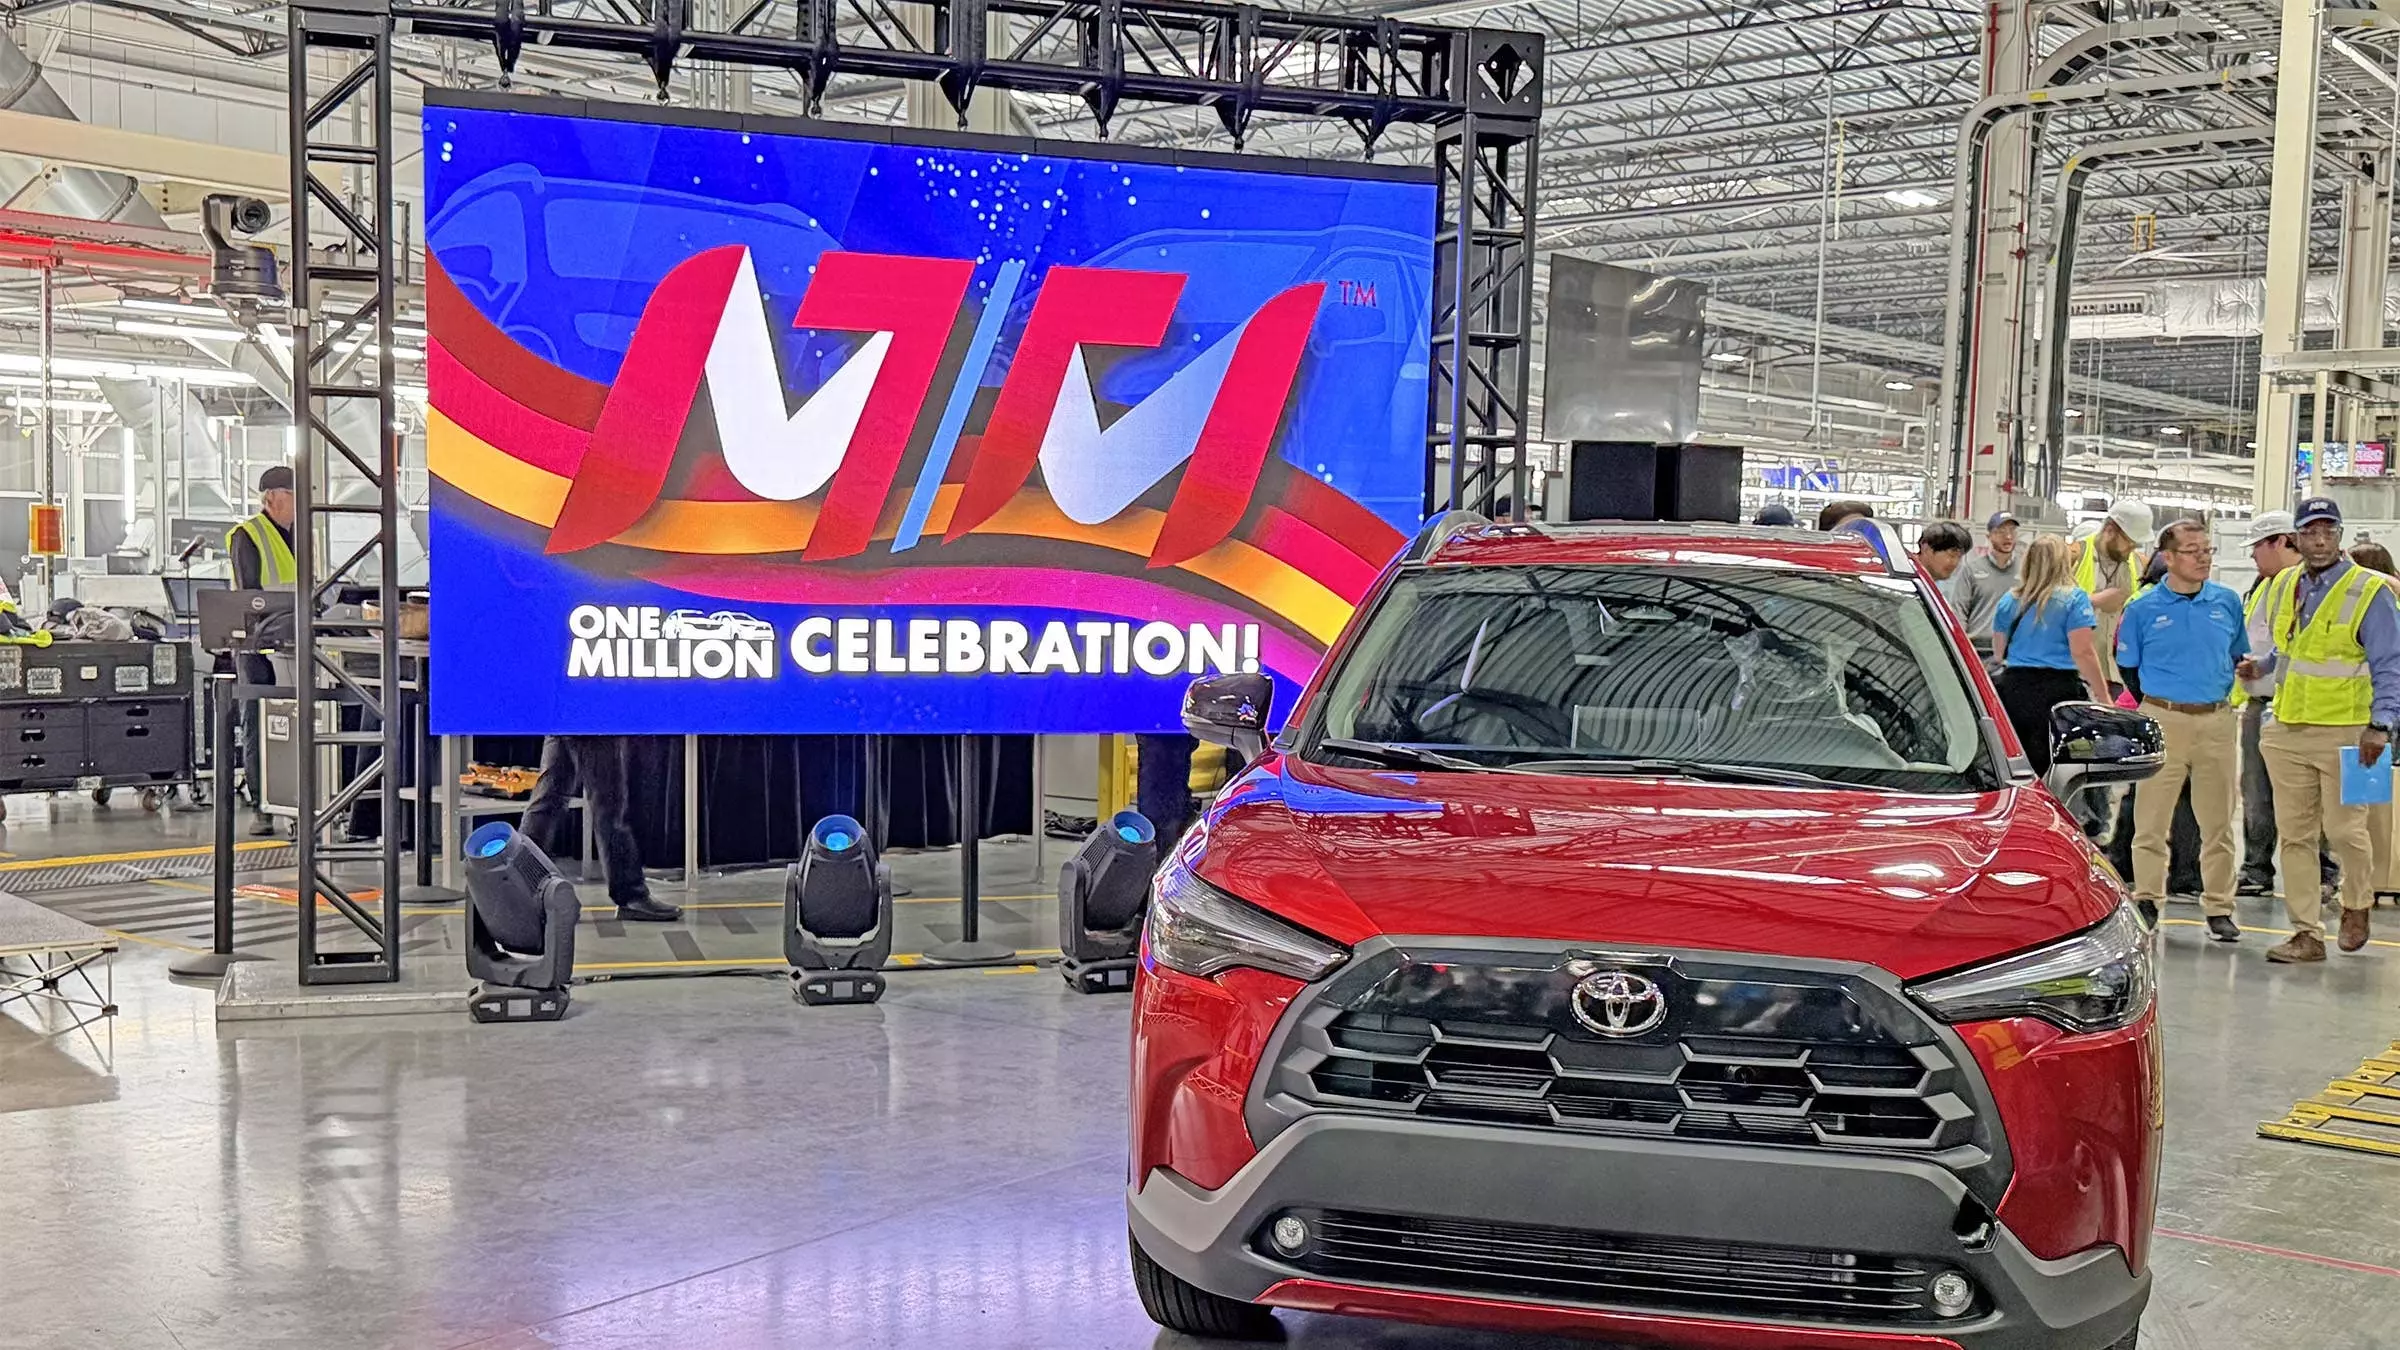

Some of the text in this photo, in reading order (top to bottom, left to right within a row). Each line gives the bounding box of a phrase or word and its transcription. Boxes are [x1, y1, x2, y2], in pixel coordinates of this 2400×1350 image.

[1338, 280, 1377, 308] TM
[568, 604, 661, 640] ONE
[567, 638, 774, 679] MILLION
[790, 617, 1260, 676] CELEBRATION!
